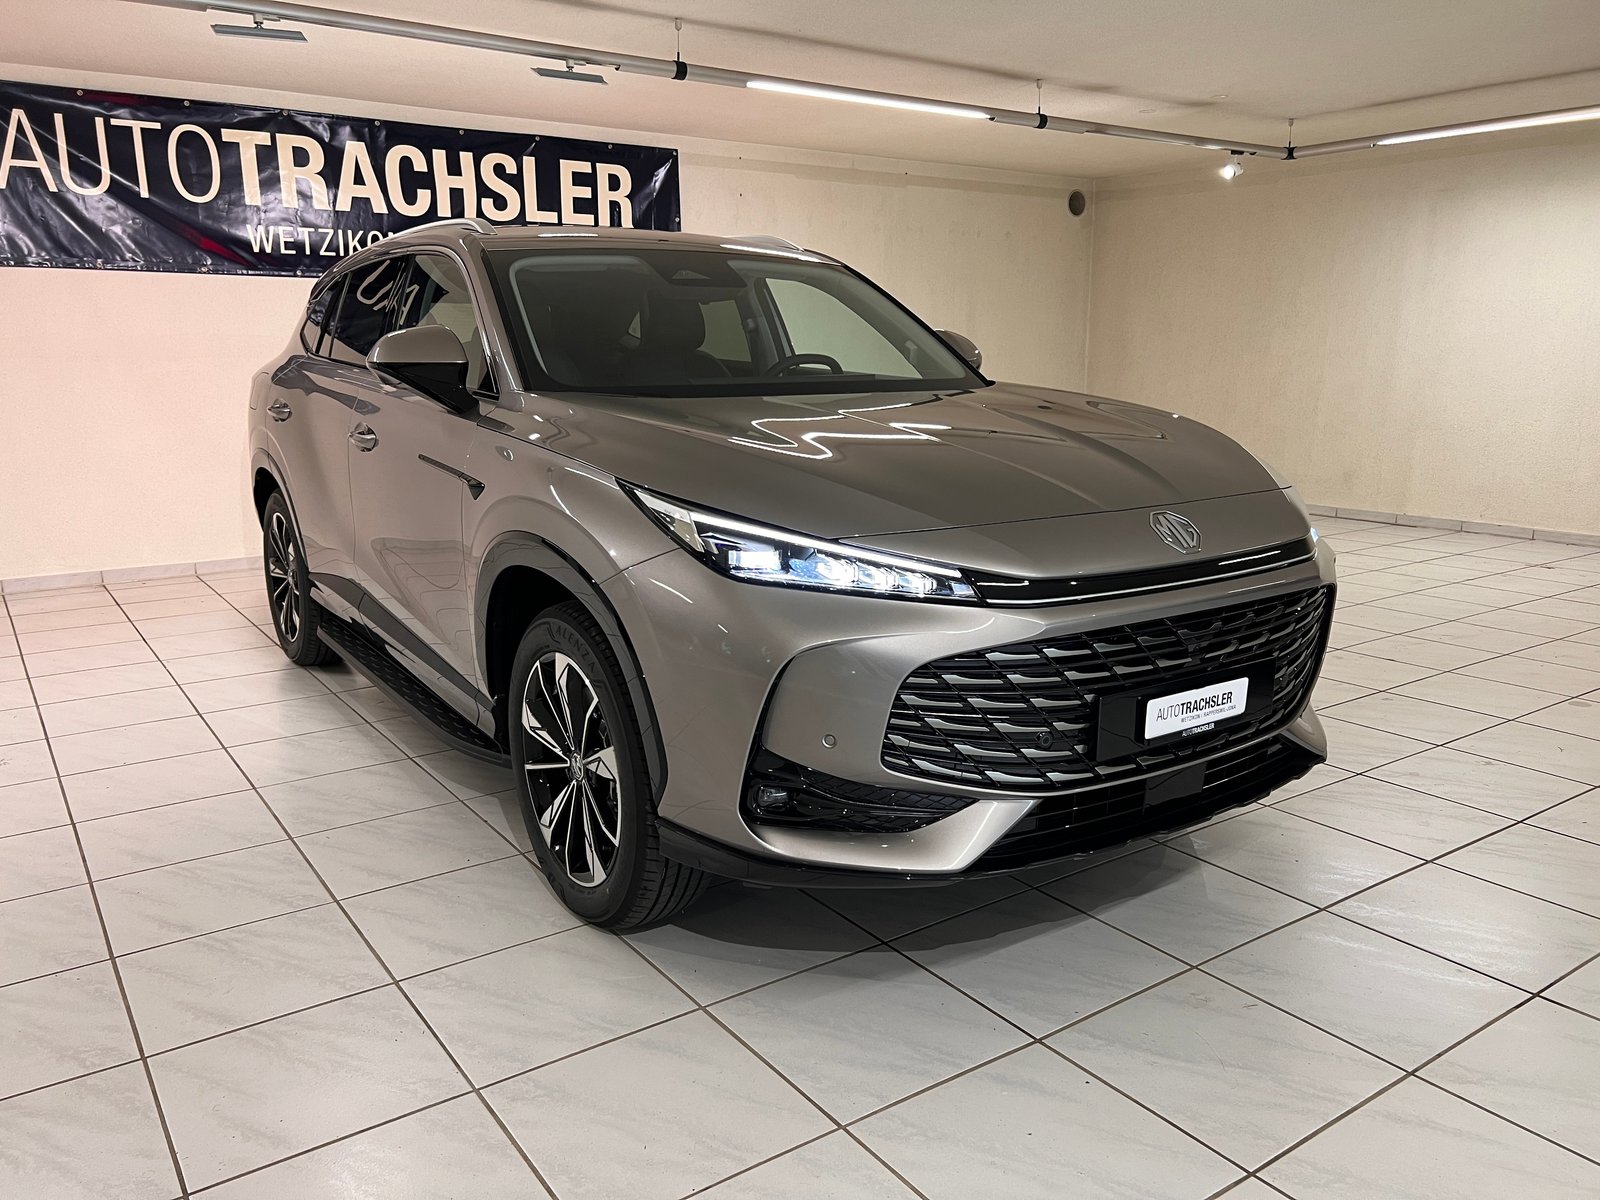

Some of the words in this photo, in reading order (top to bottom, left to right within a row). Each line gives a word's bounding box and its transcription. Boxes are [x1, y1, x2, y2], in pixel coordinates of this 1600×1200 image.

[0, 108, 635, 229] AUTOTRACHSLER
[246, 224, 398, 257] WETZIK
[1154, 513, 1198, 550] MG
[1156, 691, 1233, 722] AUTOTRACHSLER
